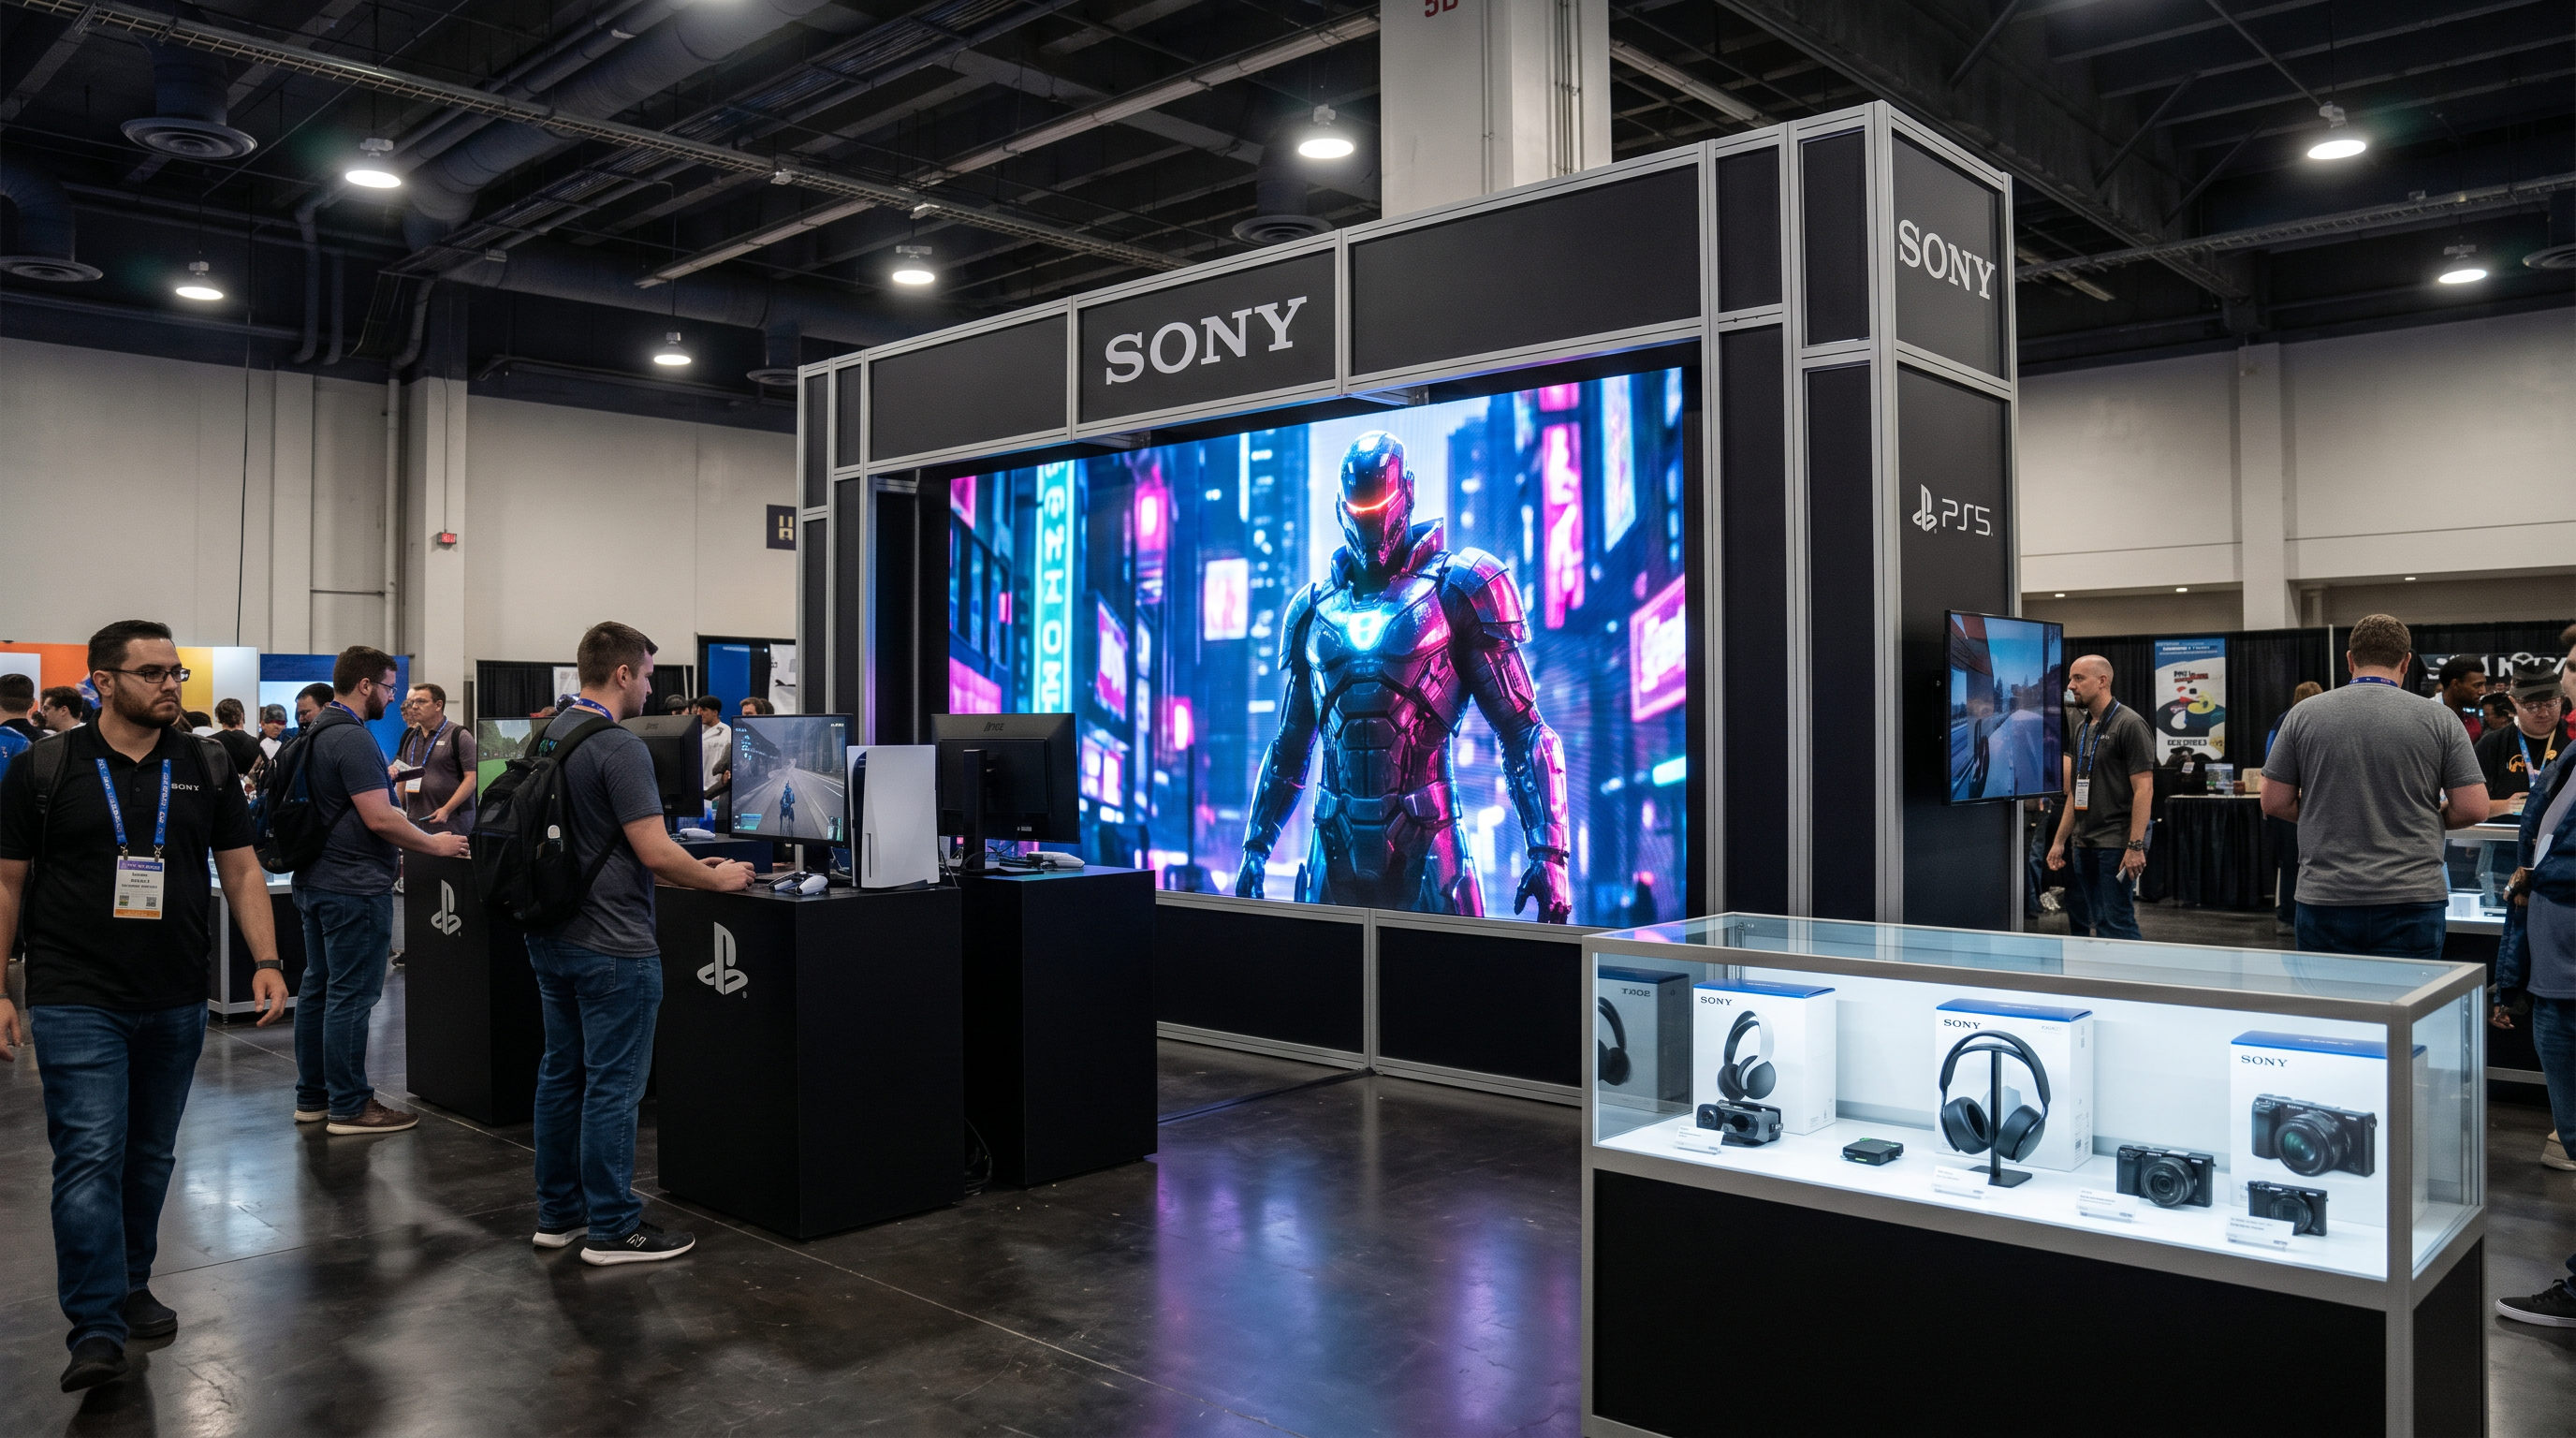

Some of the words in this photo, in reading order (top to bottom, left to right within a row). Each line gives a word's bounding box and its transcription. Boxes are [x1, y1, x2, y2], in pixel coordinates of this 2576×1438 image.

[1898, 219, 1996, 300] SONY
[1105, 296, 1308, 385] SONY
[1941, 497, 1991, 536] PS5
[171, 783, 199, 791] SONY
[1700, 996, 1733, 1006] SONY
[1943, 1019, 1981, 1030] SONY
[2241, 1054, 2288, 1067] SONY
